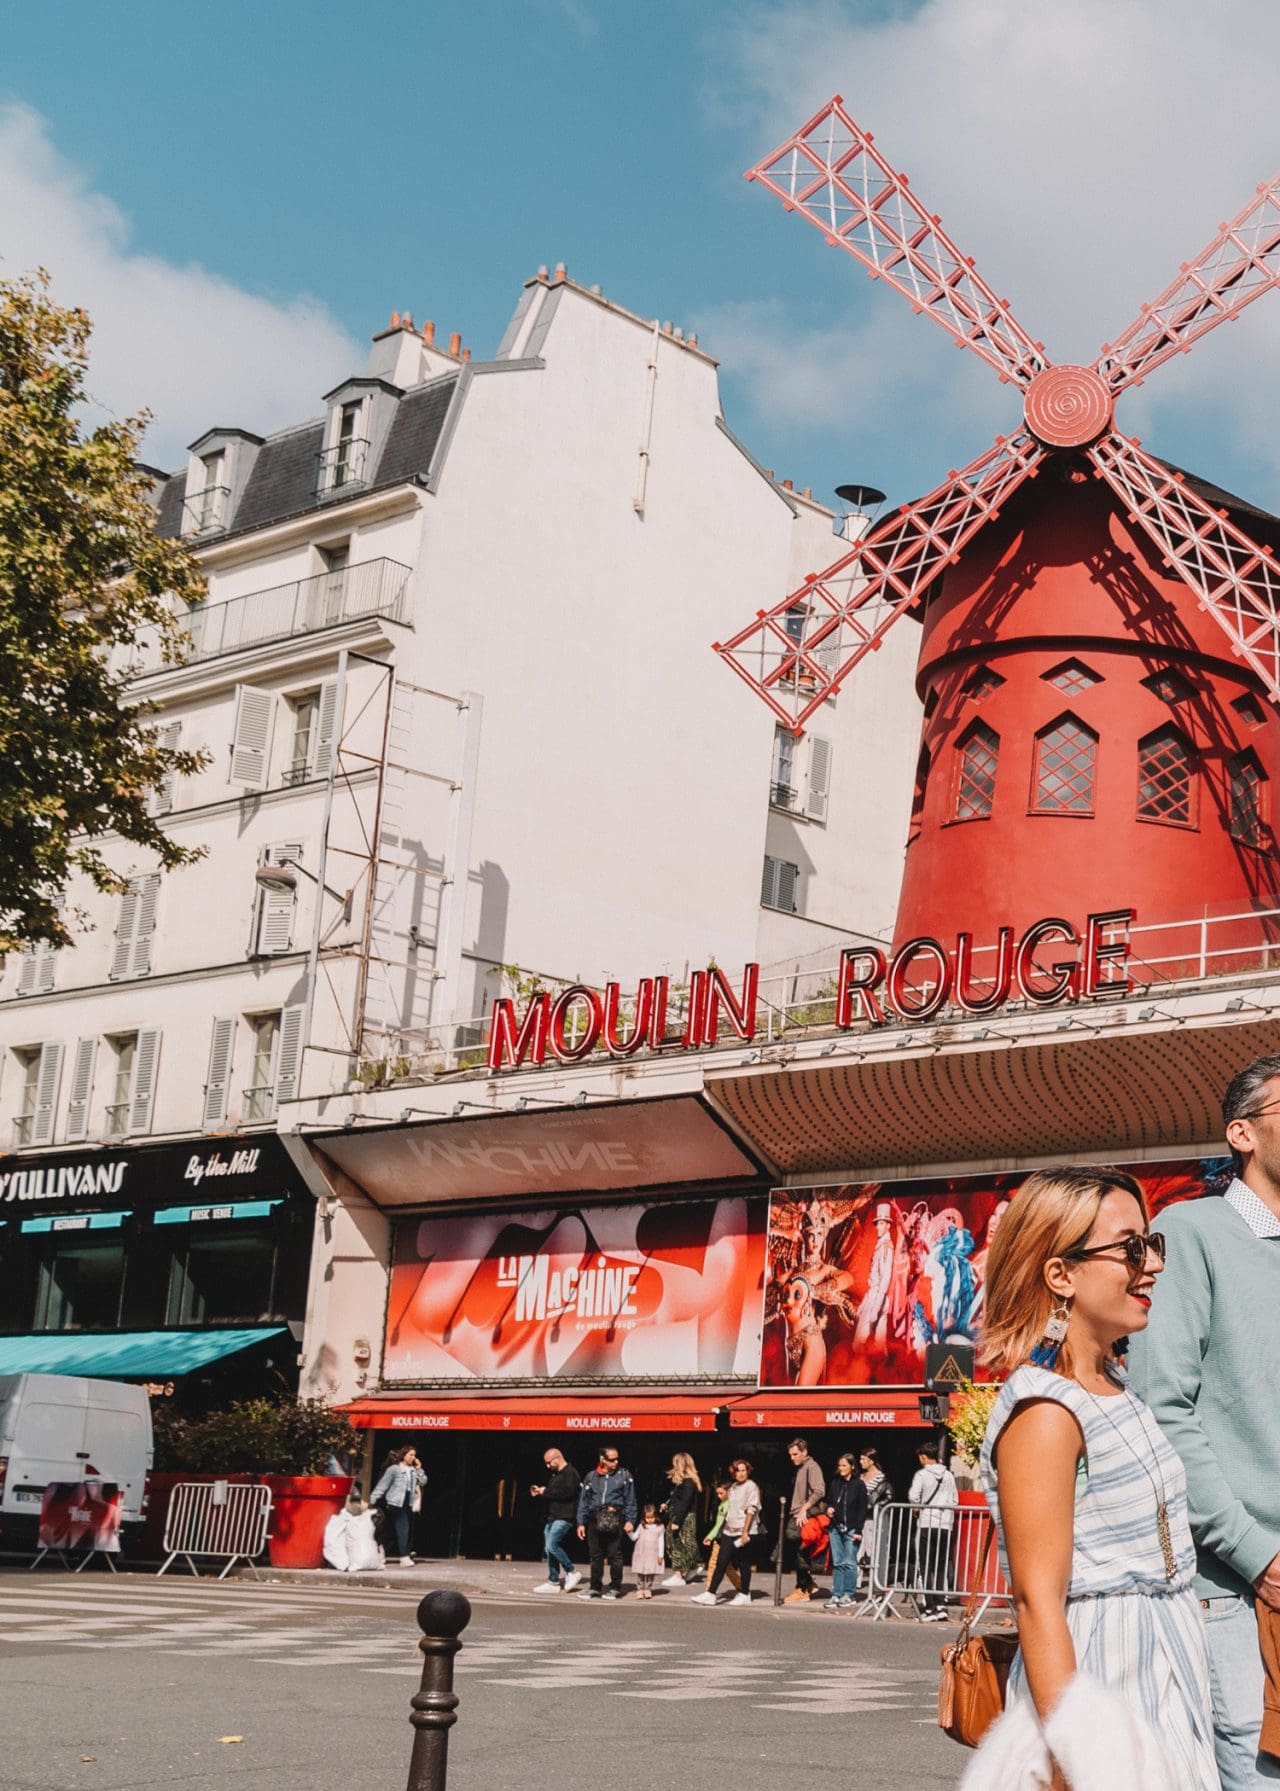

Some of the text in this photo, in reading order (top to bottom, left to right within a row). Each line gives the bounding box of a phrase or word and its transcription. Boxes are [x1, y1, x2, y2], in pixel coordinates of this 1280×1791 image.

[486, 907, 1137, 1069] MOULIN ROUGE
[184, 1148, 260, 1186] By the Mill
[498, 1256, 517, 1280] LA
[392, 1416, 449, 1427] MOULIN ROUGE
[566, 1417, 632, 1428] MOULIN ROUGE
[826, 1411, 896, 1423] MOULIN ROUGE
